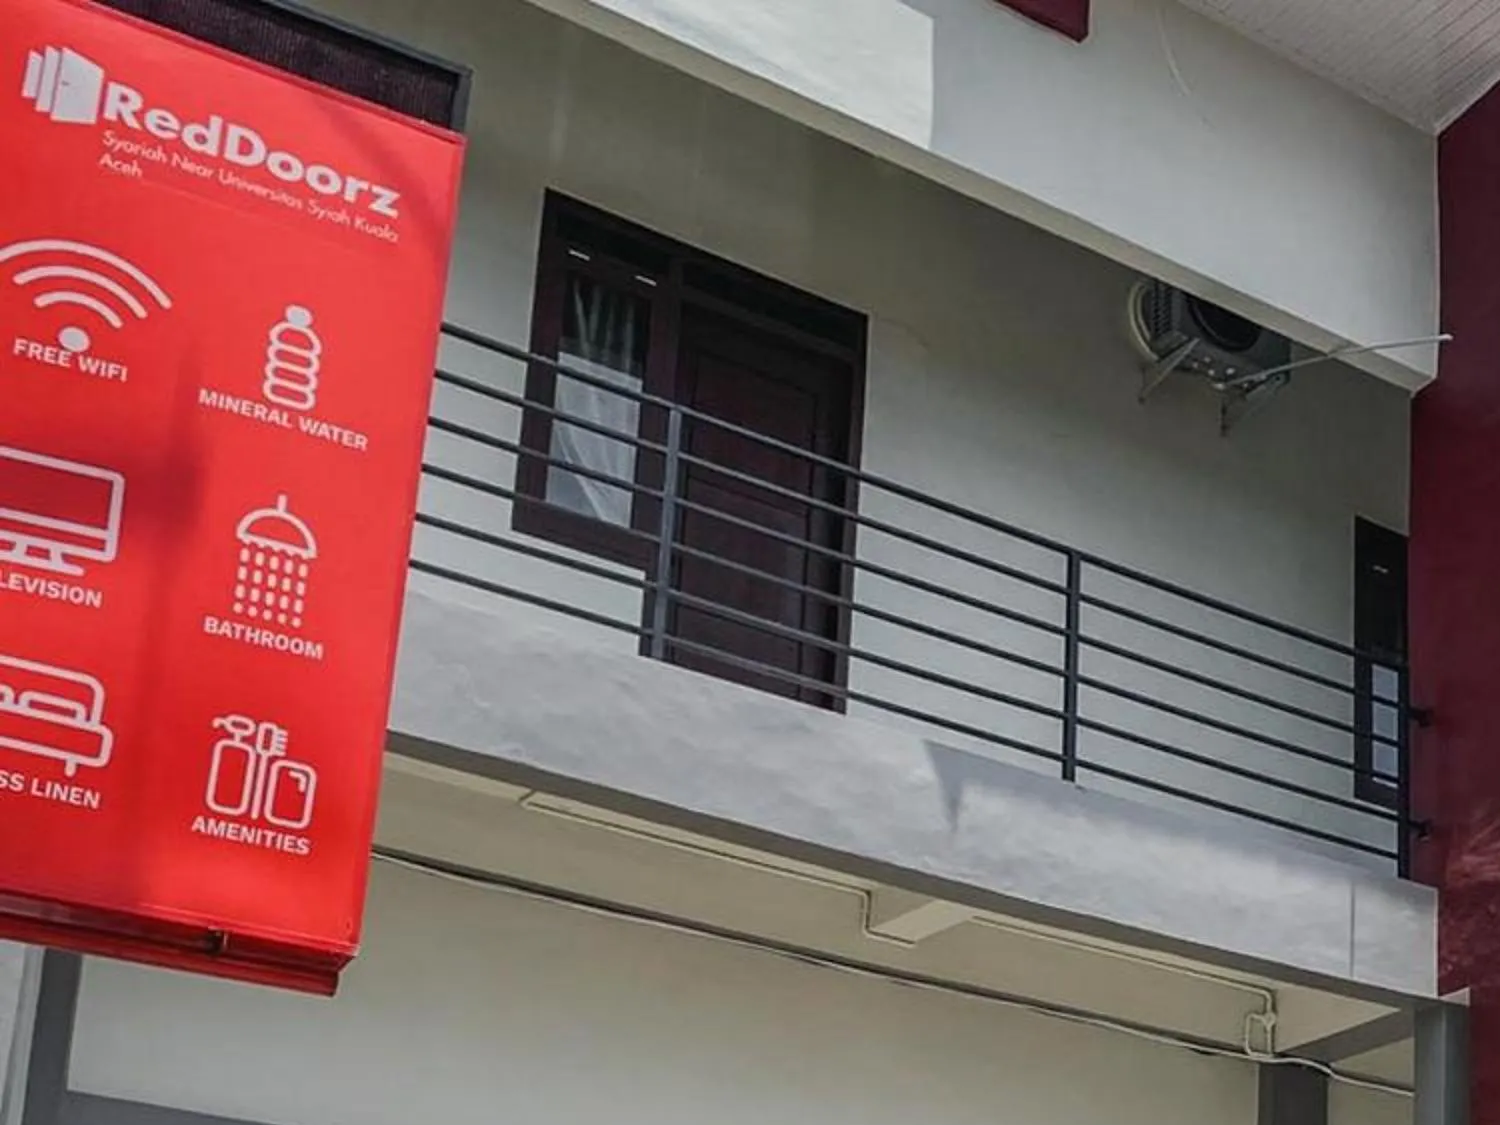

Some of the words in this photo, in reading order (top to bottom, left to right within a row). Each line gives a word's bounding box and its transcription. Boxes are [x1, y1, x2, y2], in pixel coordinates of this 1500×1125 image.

[99, 153, 143, 178] Aceh
[103, 82, 400, 219] RedDoorz
[102, 129, 167, 164] Syariah
[171, 152, 213, 179] Near
[307, 199, 350, 226] Syiah
[354, 216, 399, 243] Kuala
[13, 338, 73, 369] FREE
[78, 355, 128, 383] WIFI
[199, 388, 293, 429] MINERAL
[299, 415, 369, 452] WATER
[203, 616, 324, 661] BATHROOM
[31, 777, 101, 810] LINEN
[191, 815, 311, 856] AMENITIES
